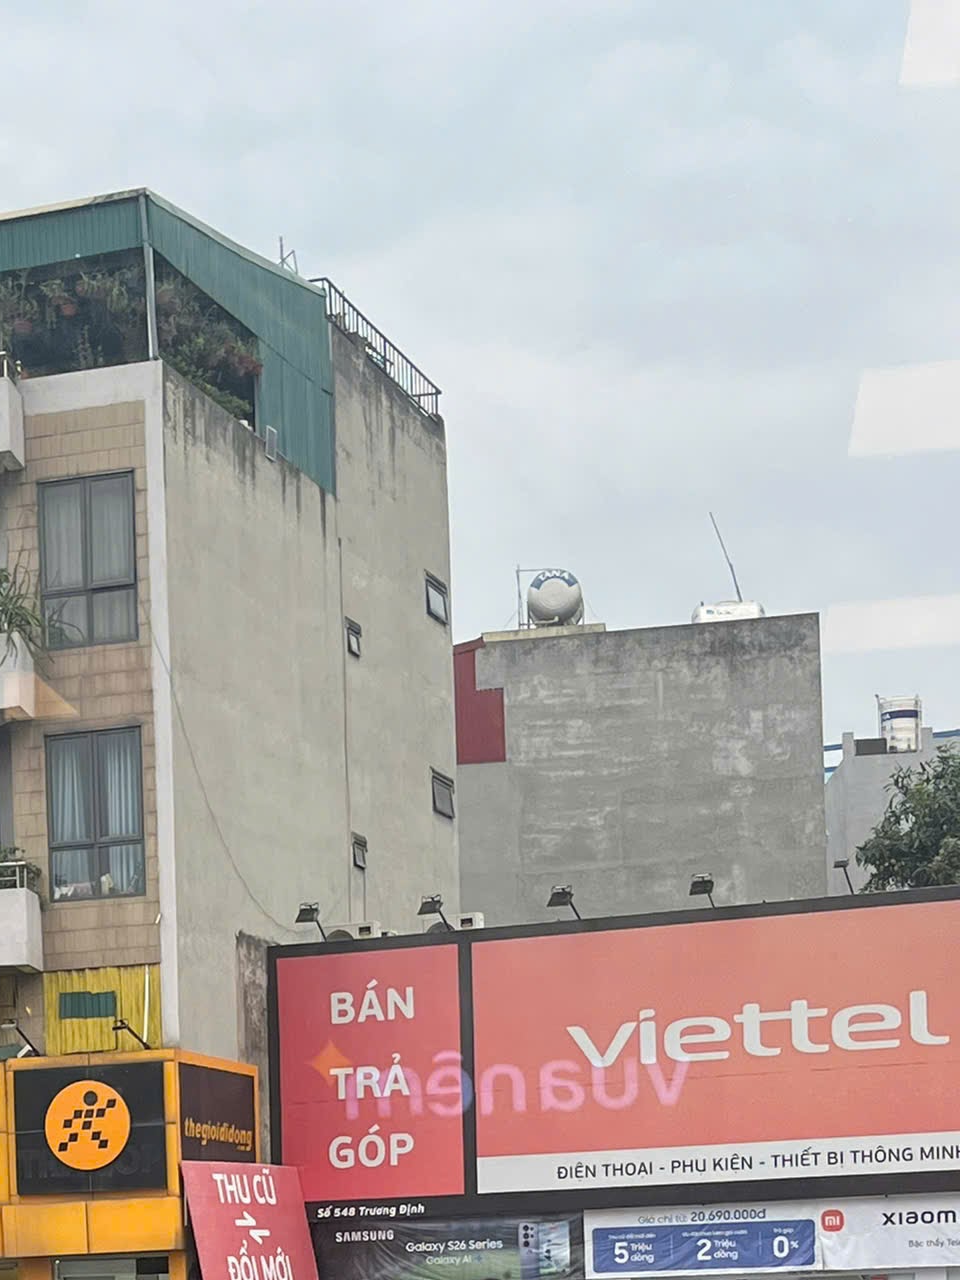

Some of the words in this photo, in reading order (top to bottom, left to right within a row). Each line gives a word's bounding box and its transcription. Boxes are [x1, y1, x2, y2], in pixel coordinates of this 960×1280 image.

[330, 978, 415, 1025] BÁN
[565, 990, 950, 1068] viettel
[329, 1053, 410, 1100] TRẢ
[184, 1117, 253, 1151] thegioididong
[328, 1124, 415, 1169] GÓP
[557, 1162, 597, 1182] ĐIỆN
[602, 1161, 653, 1179] THOẠI
[671, 1158, 707, 1176] PHỤ
[712, 1153, 753, 1173] KIỆN
[771, 1147, 821, 1168] THIẾT
[827, 1151, 844, 1168] BỊ
[850, 1145, 913, 1164] THÔNG
[212, 1173, 251, 1204] THU
[253, 1168, 277, 1205] CŨ
[317, 1205, 332, 1218] Số
[334, 1207, 355, 1217] 548
[399, 1203, 425, 1216] Định
[691, 1208, 767, 1222] 20.690.000đ
[335, 1230, 394, 1243] SAMSUNG
[405, 1242, 445, 1254] Galaxy
[447, 1240, 467, 1251] S26
[469, 1239, 503, 1250] Series
[696, 1239, 712, 1260] 2
[426, 1255, 460, 1266] Galaxy
[614, 1242, 629, 1264] 5
